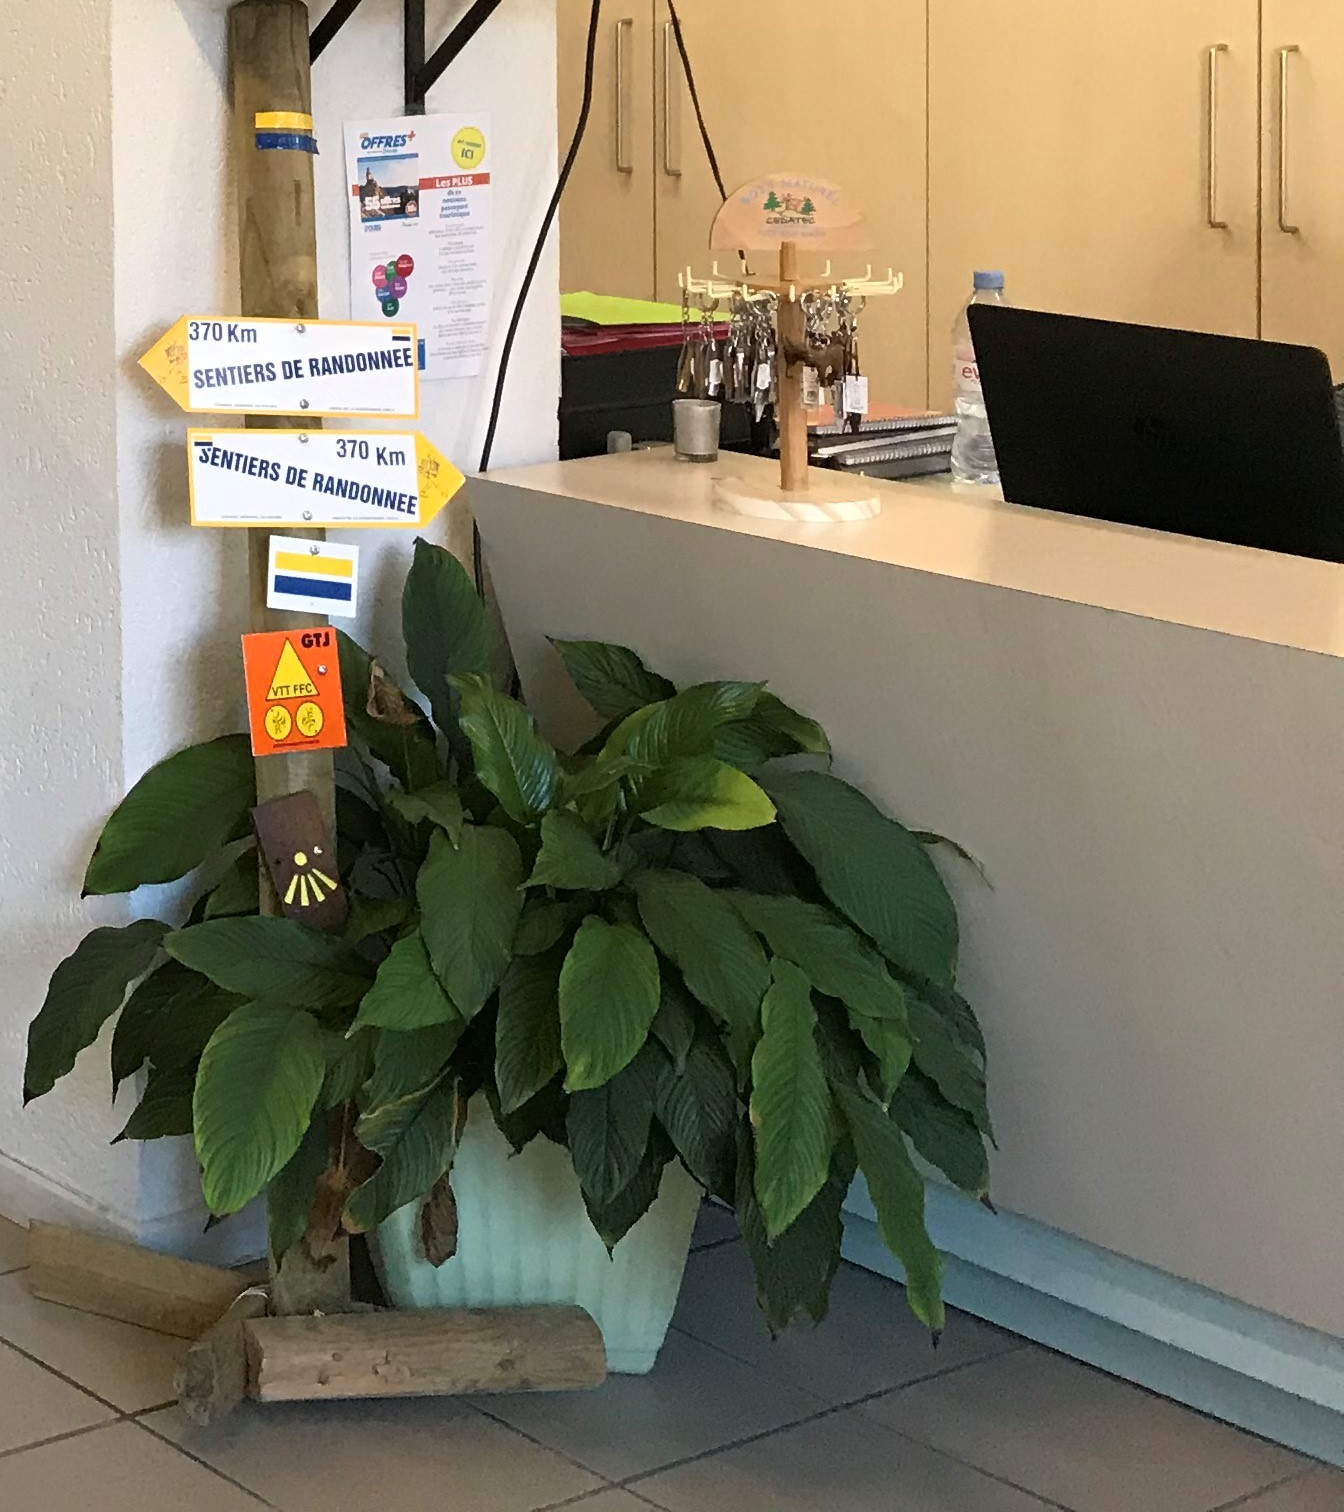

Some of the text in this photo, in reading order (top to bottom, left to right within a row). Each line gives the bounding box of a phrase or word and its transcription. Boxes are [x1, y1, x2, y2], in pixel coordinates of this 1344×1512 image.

[435, 176, 473, 188] Les PLUS
[189, 321, 258, 343] 370 Km
[193, 347, 414, 389] SENTIERS DE RANDONNEE
[335, 438, 406, 466] 370 Km
[198, 445, 418, 515] SENTIERS DE RANDONNEE
[301, 632, 330, 649] GTJ
[272, 682, 313, 696] VTT FFC
